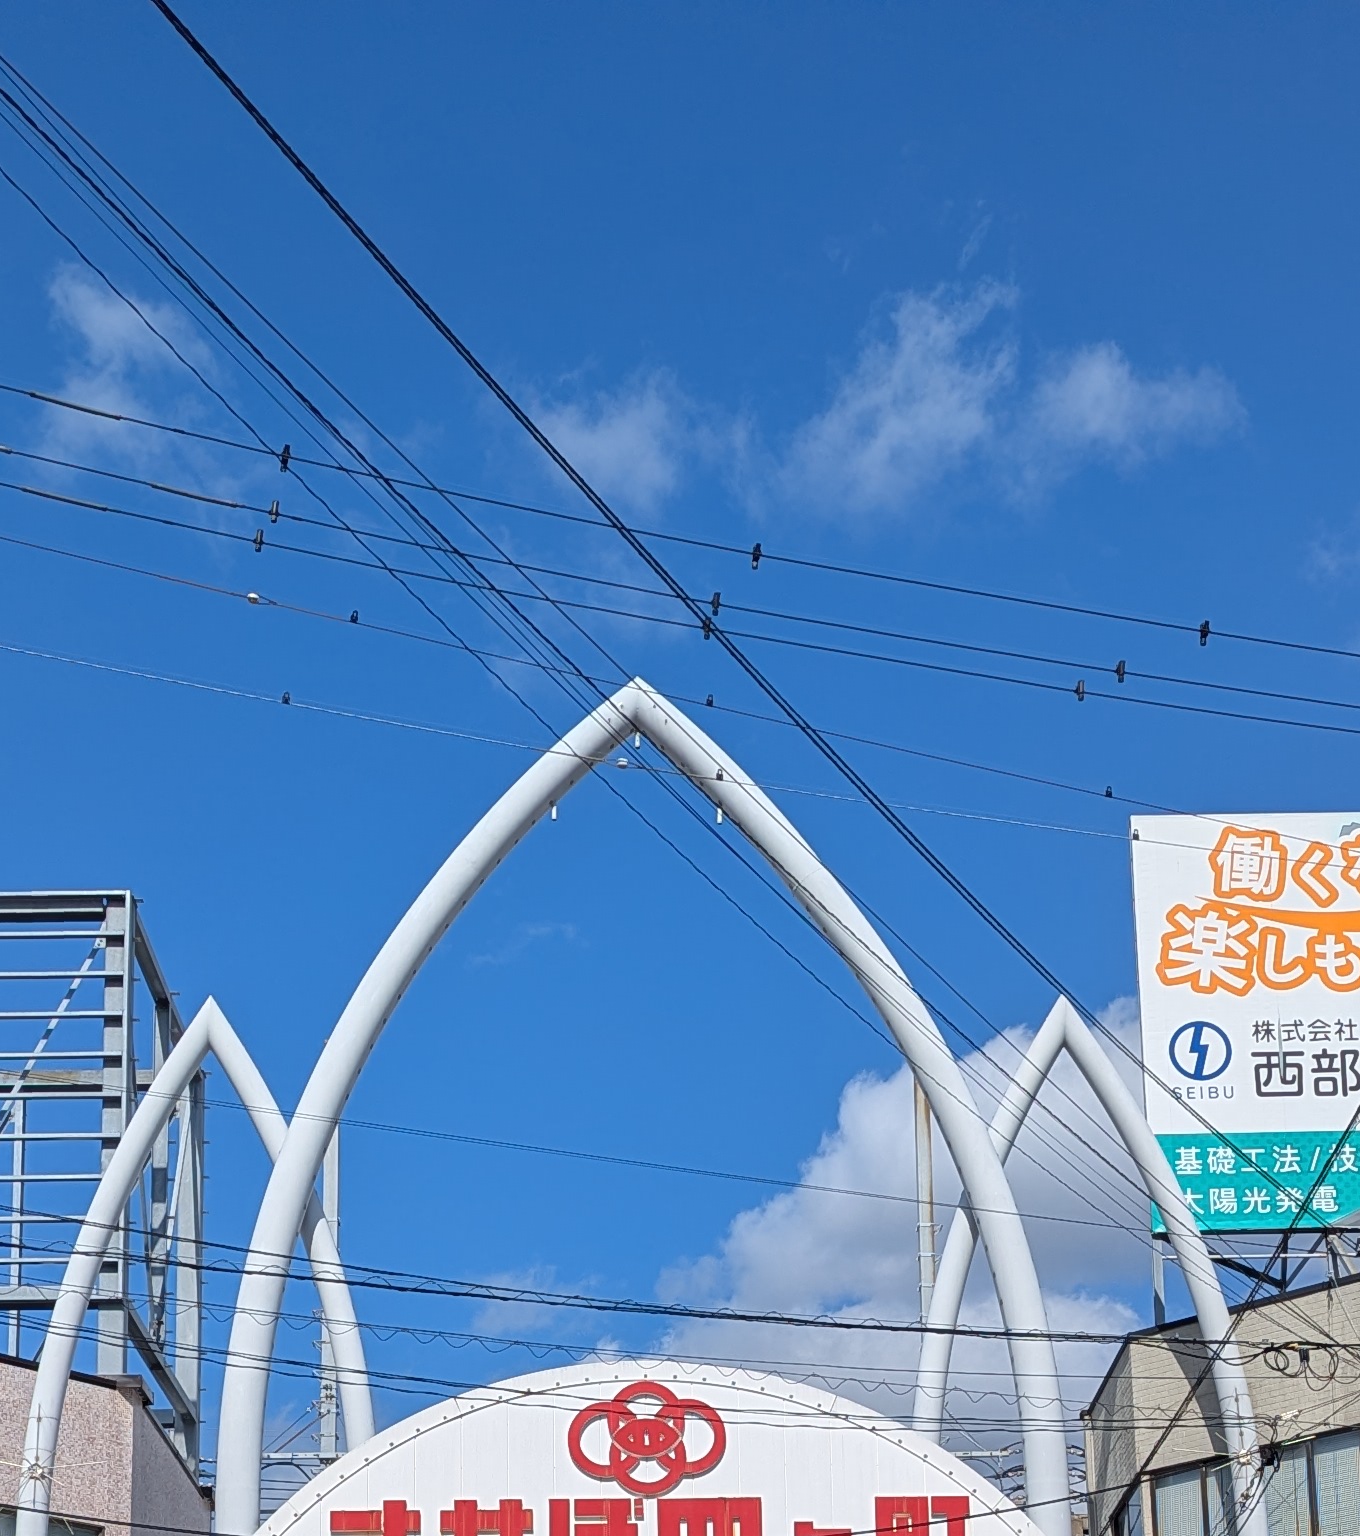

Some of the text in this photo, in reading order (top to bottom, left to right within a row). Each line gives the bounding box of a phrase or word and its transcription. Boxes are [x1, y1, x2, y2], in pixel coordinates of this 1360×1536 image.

[1252, 1018, 1360, 1043] 株式会社
[1172, 1085, 1235, 1100] SEIBU
